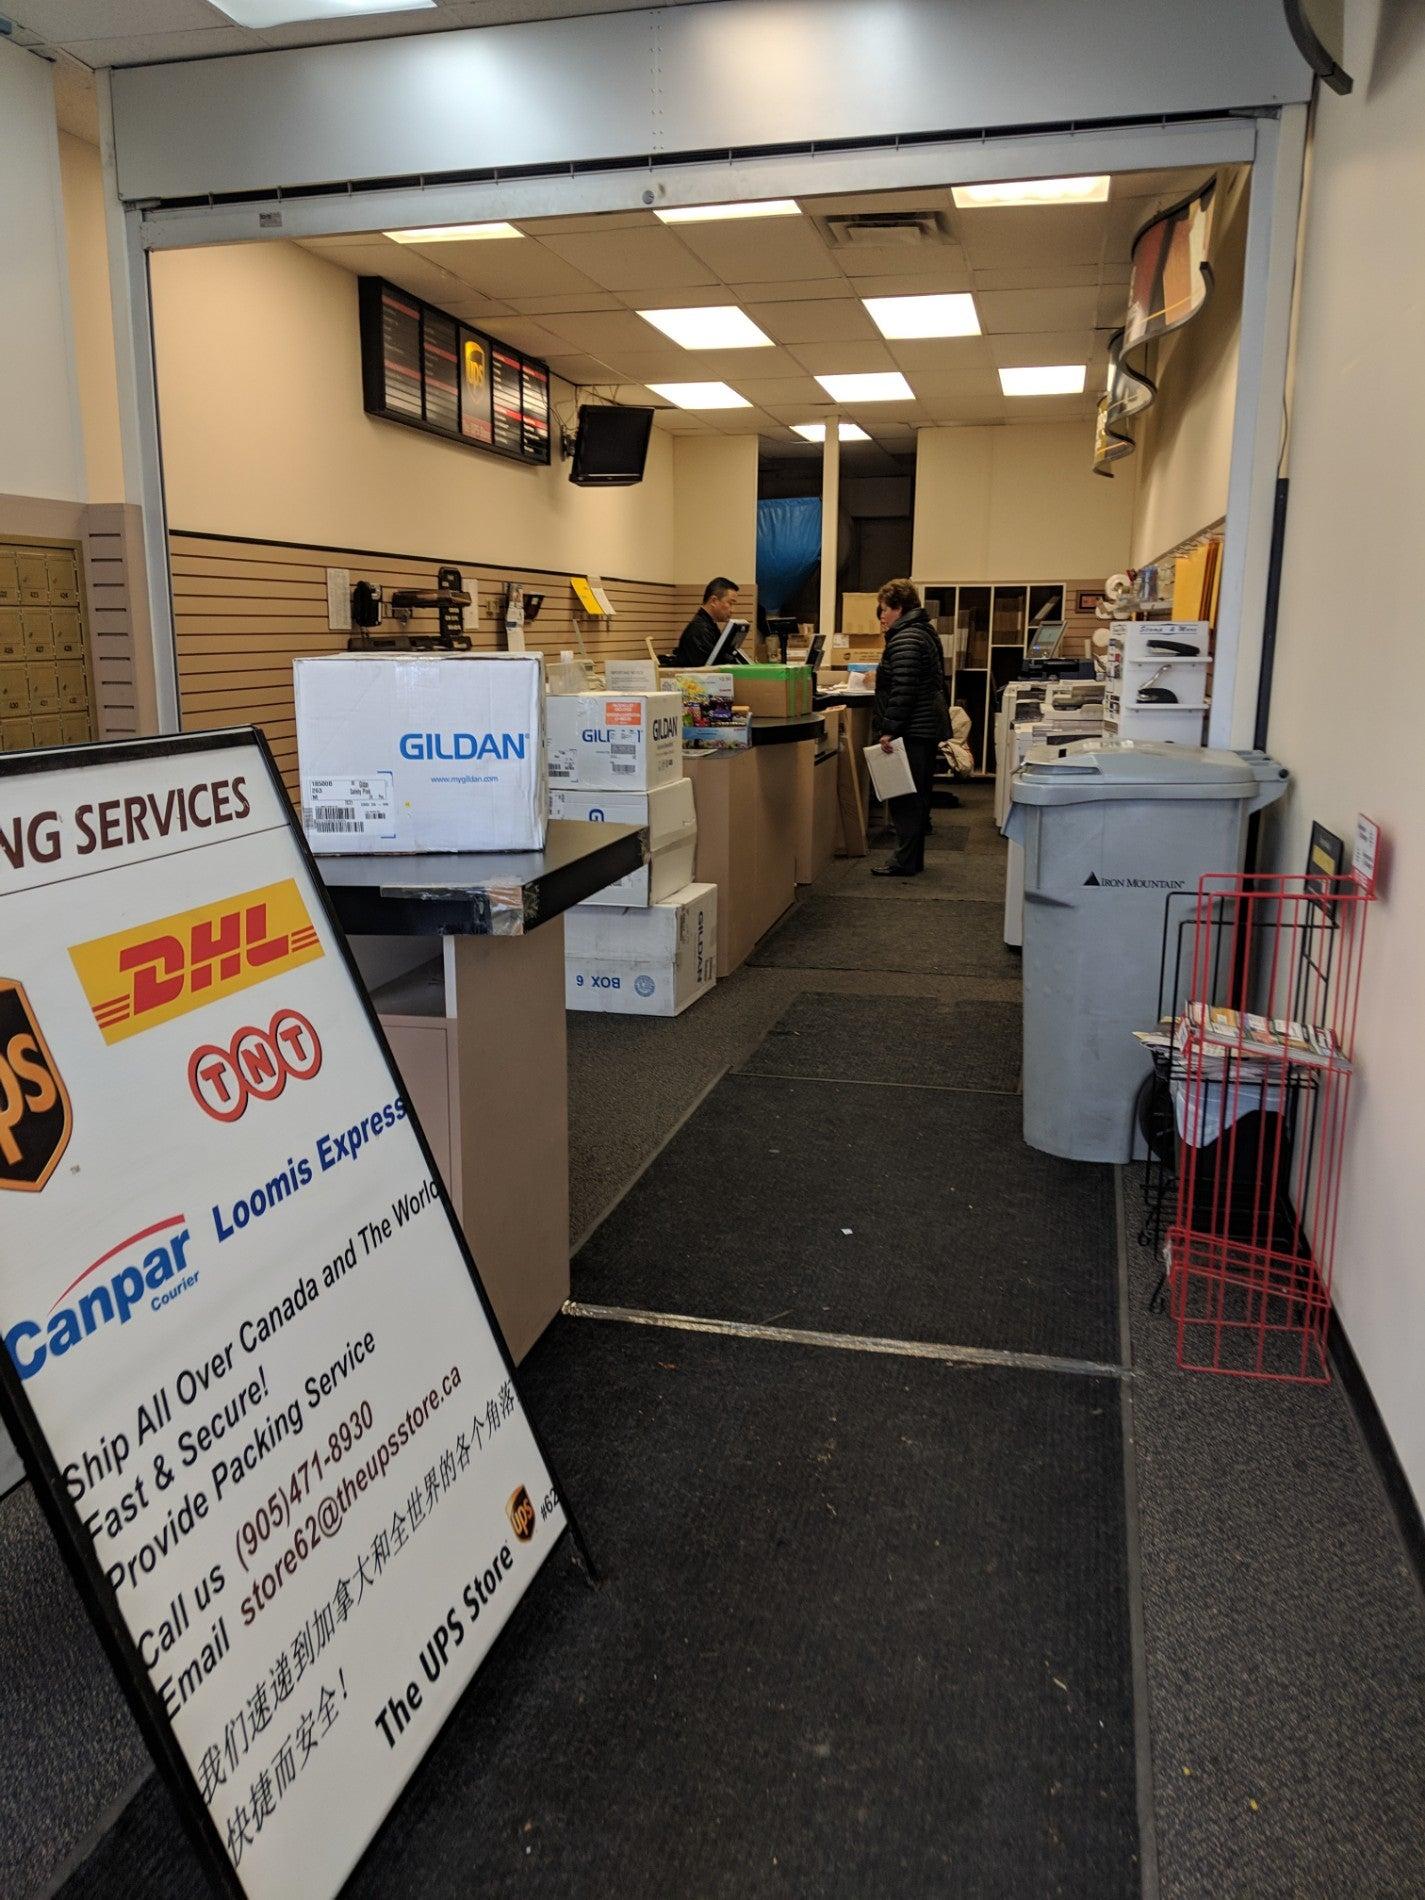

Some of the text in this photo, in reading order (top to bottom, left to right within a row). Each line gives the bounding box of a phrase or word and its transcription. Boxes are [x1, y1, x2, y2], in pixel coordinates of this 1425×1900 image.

[400, 733, 525, 760] GILDAN
[652, 716, 678, 741] GILDAN
[75, 776, 251, 855] SERVICES
[431, 775, 499, 784] www.mygildan.com
[1101, 878, 1183, 888] IRON MOUNTAIN
[119, 902, 289, 1016] DHL
[576, 975, 584, 987] 6
[591, 976, 621, 989] BOX
[199, 1023, 308, 1103] TNT
[212, 1095, 408, 1243] Loomis Express
[3, 1229, 191, 1381] Canpar
[151, 1271, 200, 1312] Courier
[62, 1433, 130, 1502] Ship
[137, 1387, 172, 1446] All
[176, 1343, 233, 1405] Over
[239, 1278, 319, 1353] Canada
[322, 1239, 358, 1288] and
[358, 1218, 392, 1255] The
[83, 1365, 269, 1541] Fast & Secure!
[104, 1332, 376, 1593] Provide Packing Service
[138, 1400, 373, 1671] Call us (905)471-8930
[157, 1366, 463, 1720] Email store62@theupsstore.ca
[511, 1498, 533, 1536] ups
[374, 1544, 514, 1749] The UPS Store
